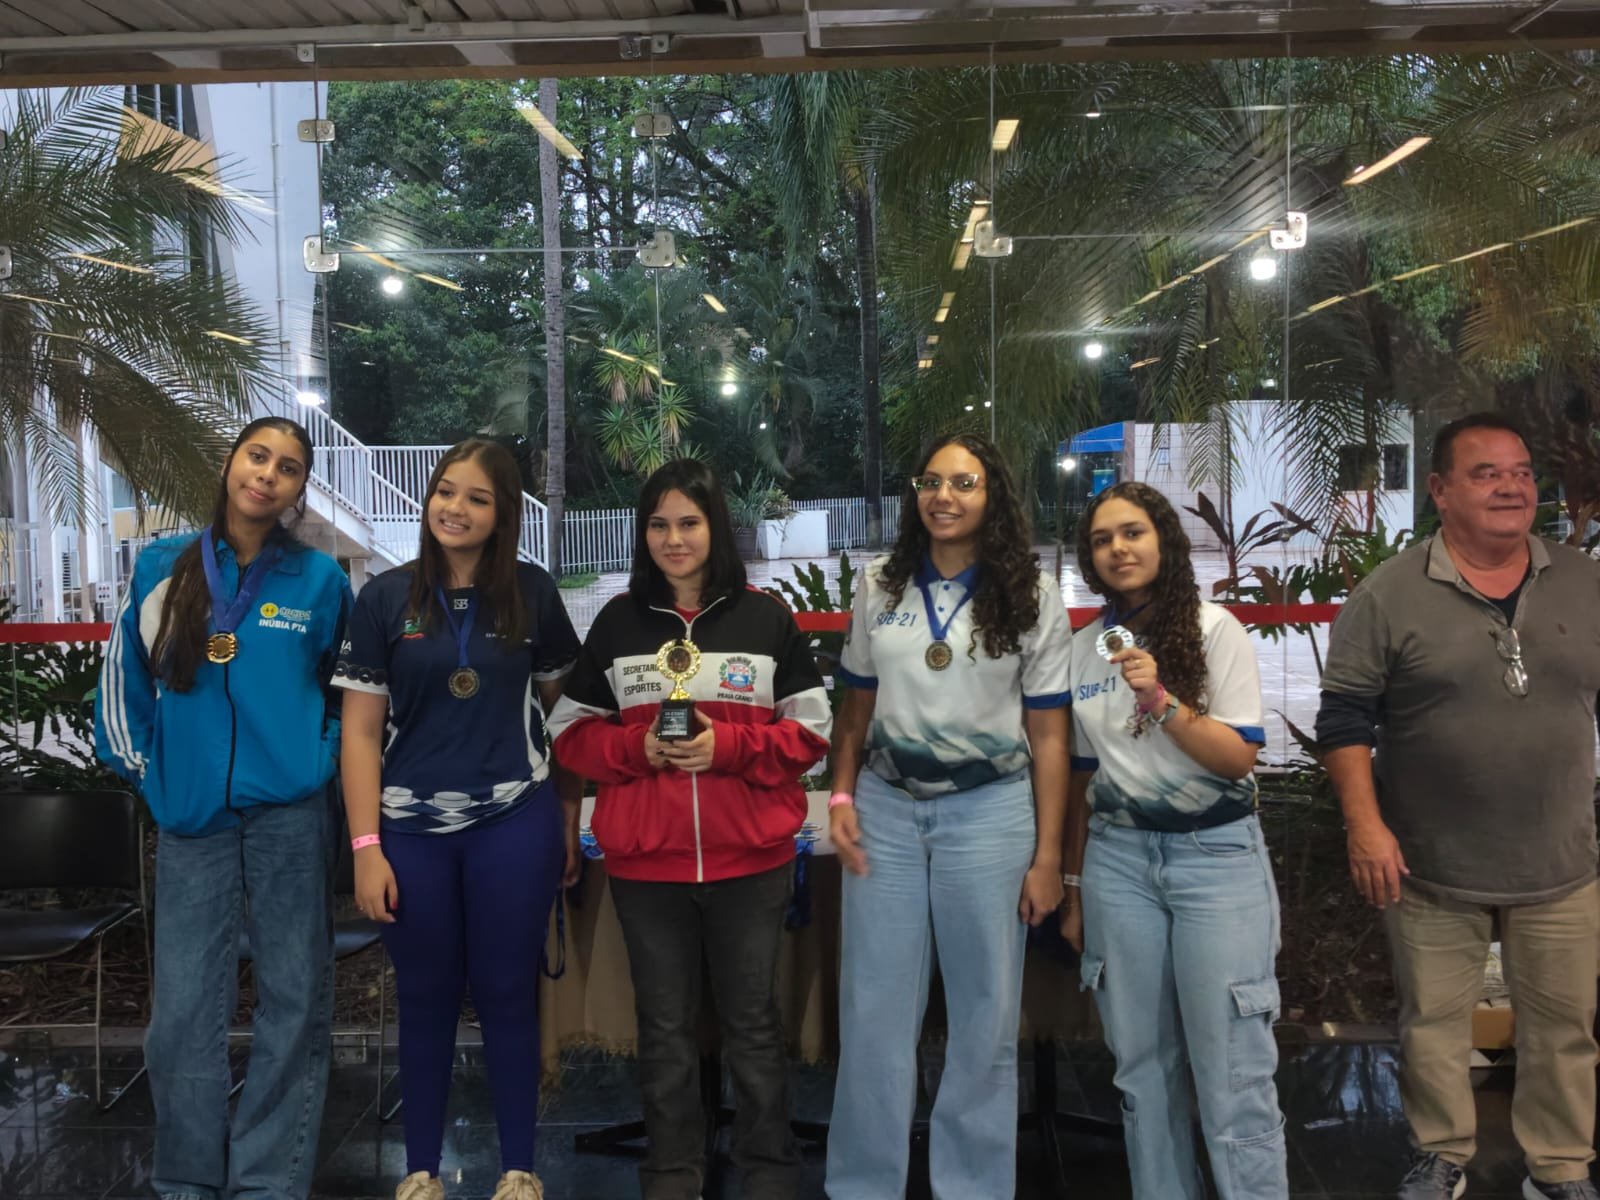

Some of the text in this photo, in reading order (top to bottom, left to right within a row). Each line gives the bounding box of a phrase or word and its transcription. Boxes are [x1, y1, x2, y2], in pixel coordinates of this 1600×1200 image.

[876, 611, 917, 627] SUB-21
[291, 622, 307, 634] PTA
[623, 663, 659, 676] SECRETARI
[623, 682, 662, 697] ESPORTES
[1079, 676, 1117, 701] SUB-21
